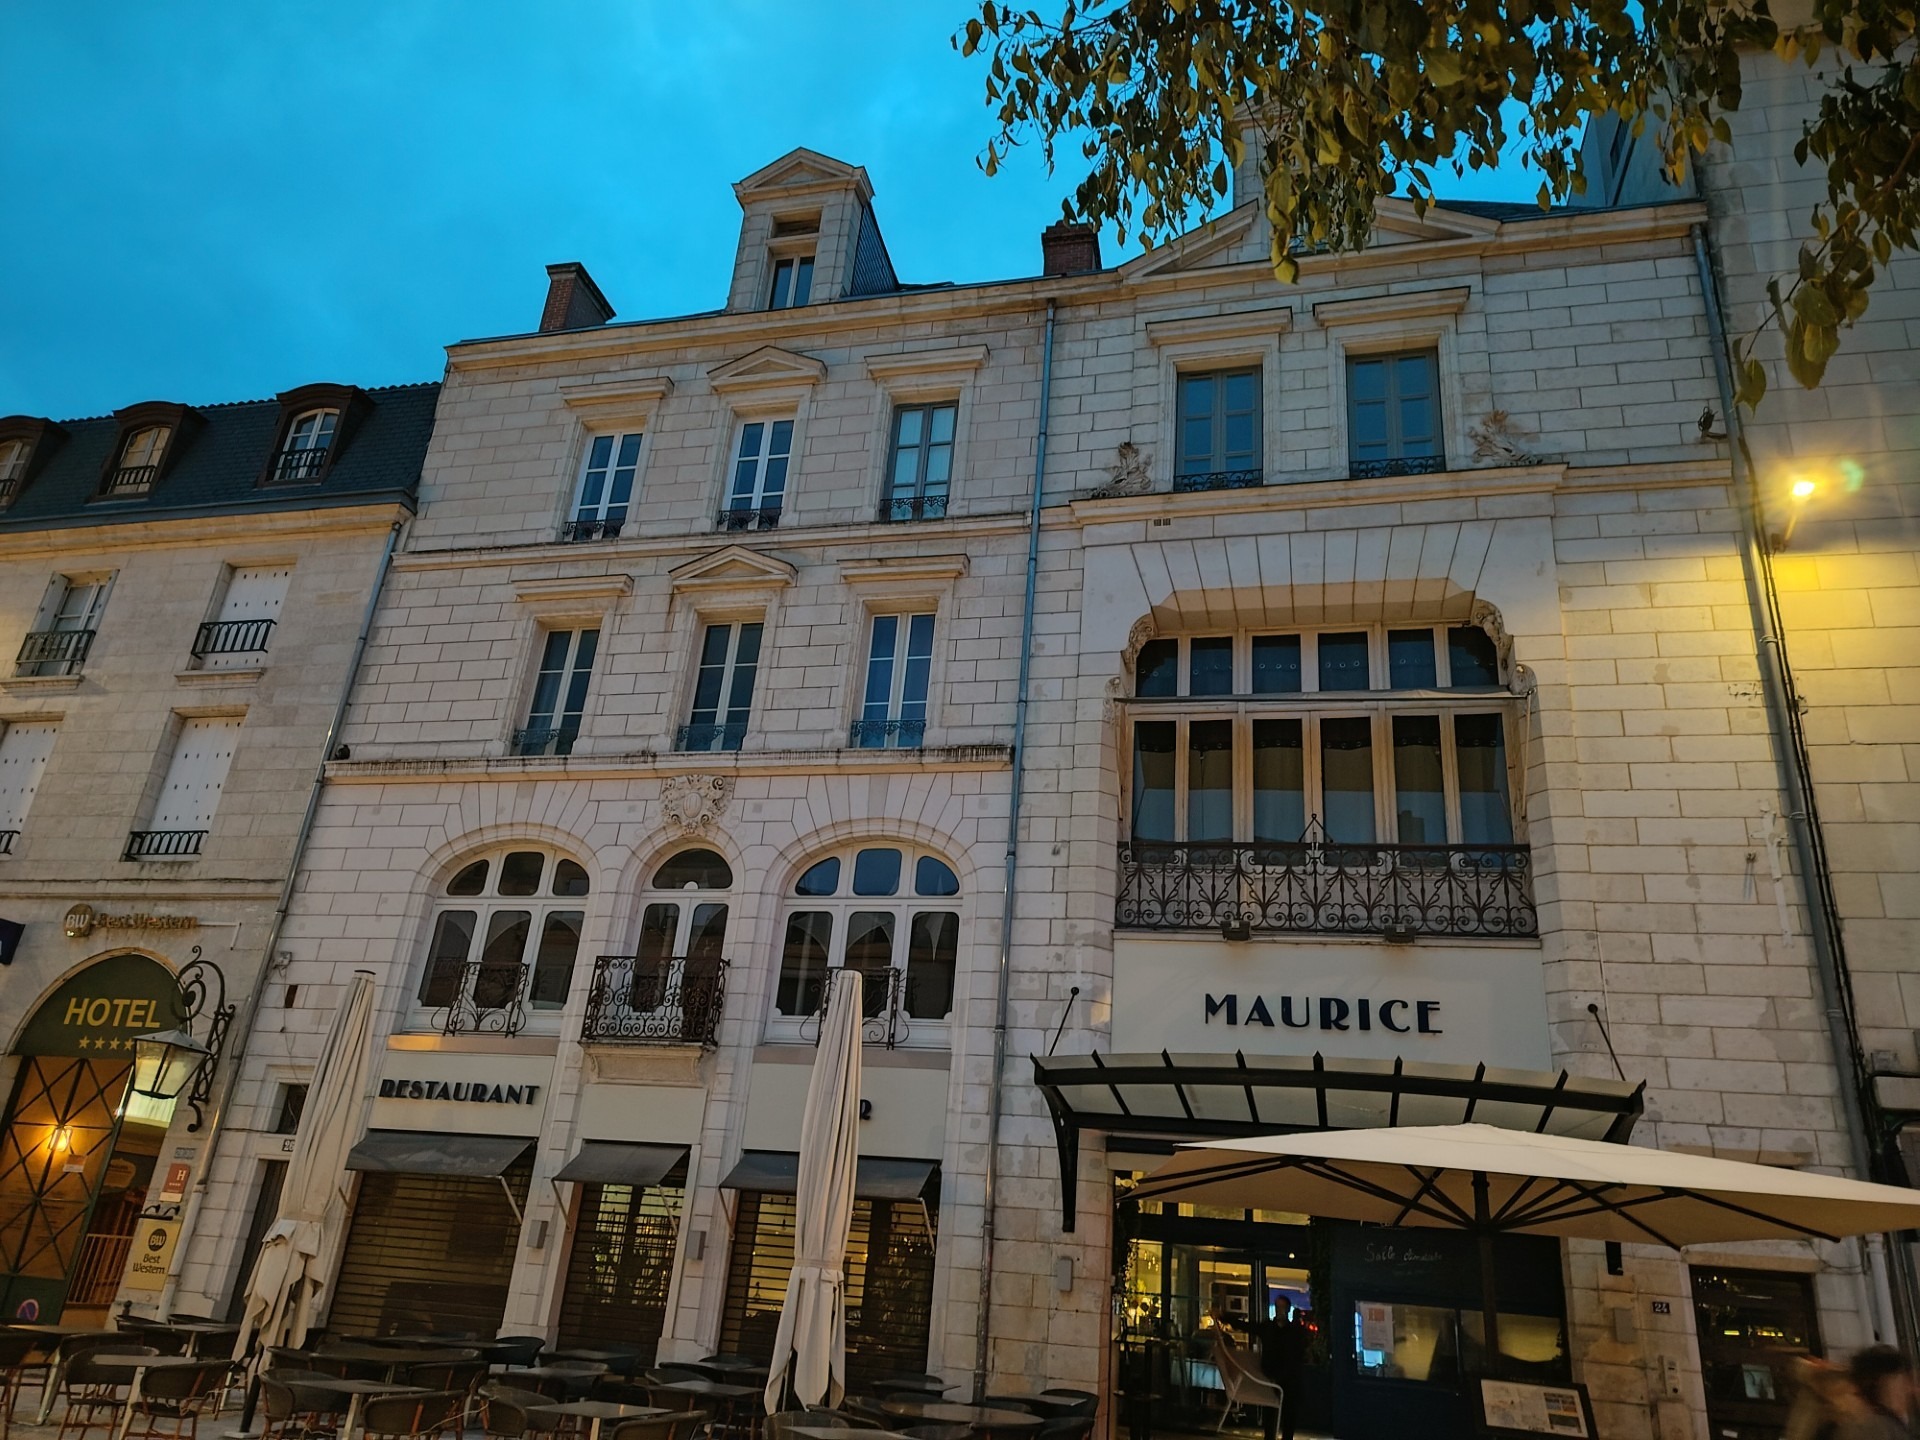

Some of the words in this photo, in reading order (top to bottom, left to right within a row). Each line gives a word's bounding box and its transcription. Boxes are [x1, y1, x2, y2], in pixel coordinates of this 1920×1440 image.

[63, 997, 160, 1028] HOTEL
[1205, 993, 1443, 1034] MAURICE
[379, 1079, 540, 1105] RESTAURANT
[177, 1169, 186, 1181] H
[143, 1253, 161, 1264] Best
[132, 1262, 166, 1274] Western
[1654, 1303, 1668, 1313] 24
